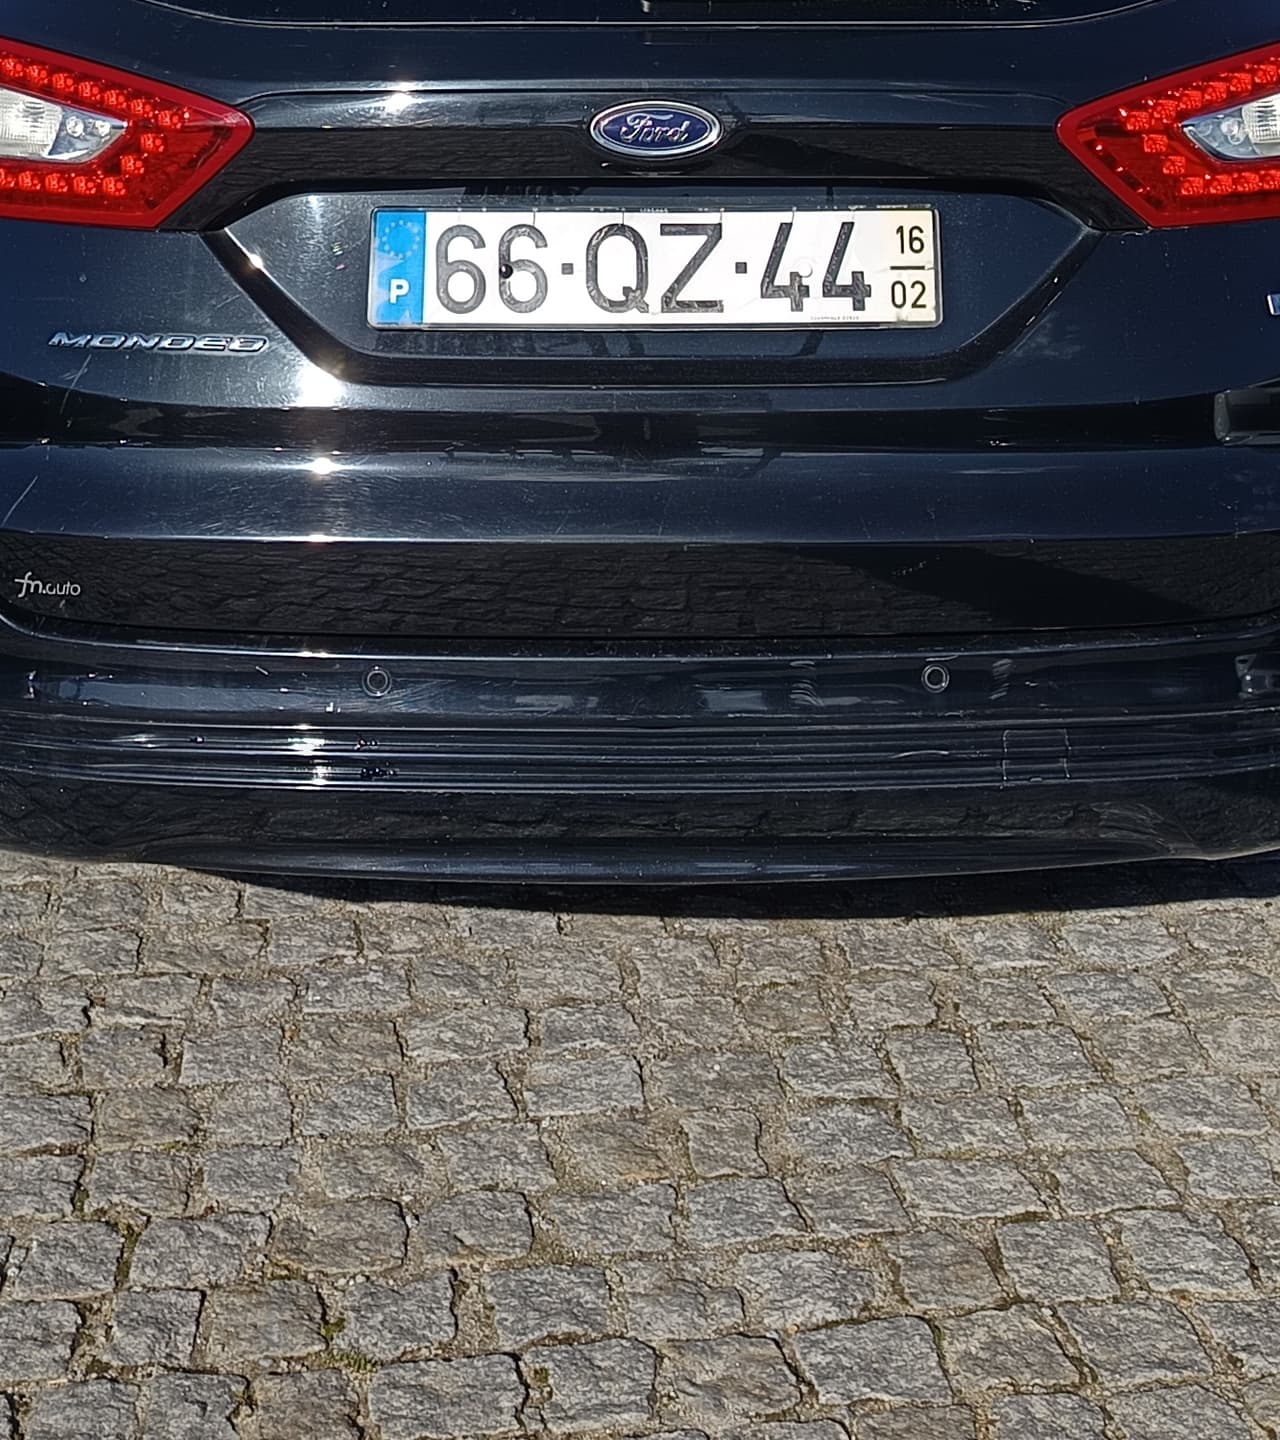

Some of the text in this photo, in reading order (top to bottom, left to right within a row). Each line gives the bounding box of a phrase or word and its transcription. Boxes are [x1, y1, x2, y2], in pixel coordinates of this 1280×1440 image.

[620, 112, 691, 142] Ford
[896, 225, 925, 254] 16
[389, 278, 409, 304] P
[890, 280, 927, 309] 02
[48, 331, 269, 354] MONDEO
